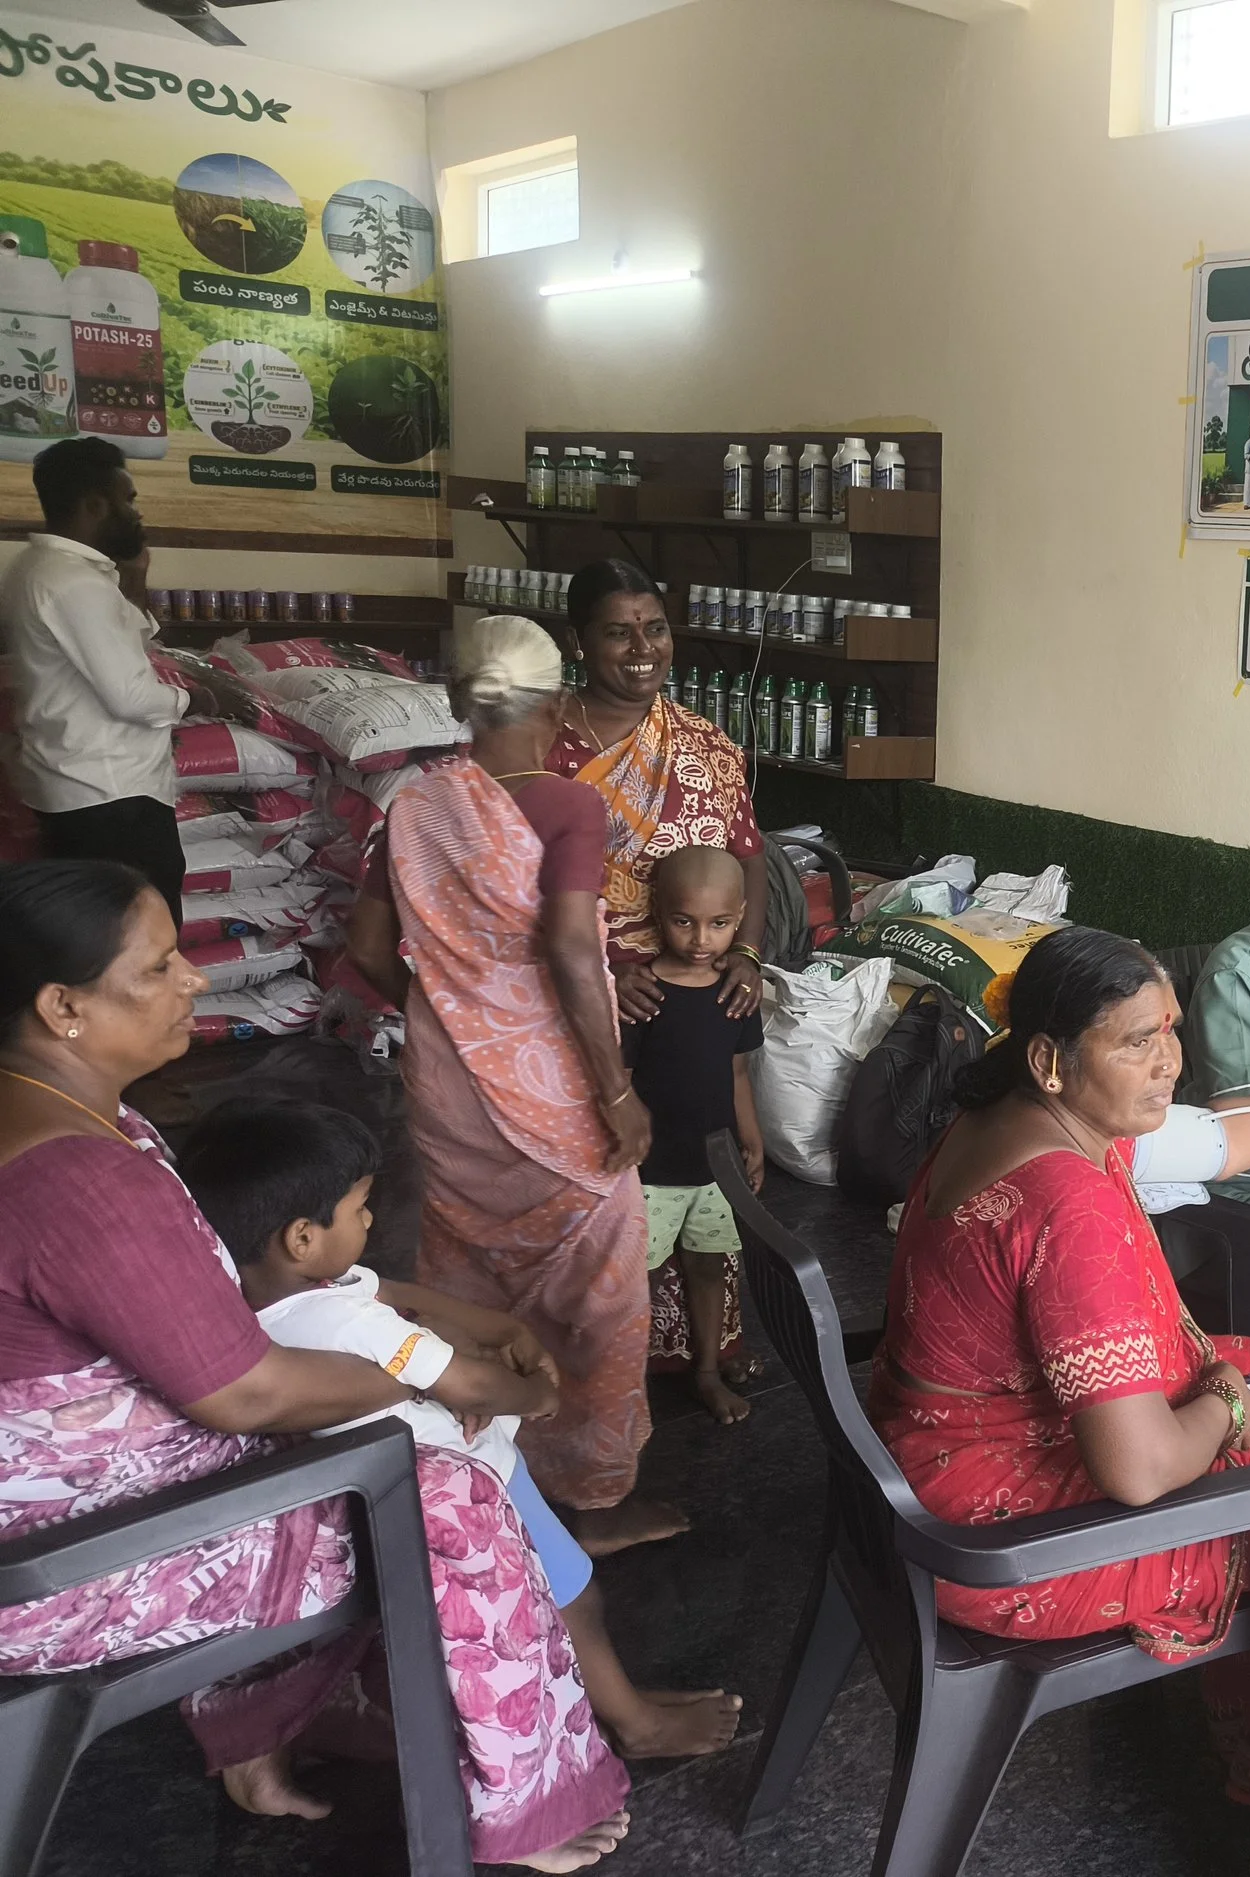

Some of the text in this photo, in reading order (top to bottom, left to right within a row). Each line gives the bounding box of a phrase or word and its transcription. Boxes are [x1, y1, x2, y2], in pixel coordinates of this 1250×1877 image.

[193, 280, 298, 309] పంట నాణ్యత
[74, 326, 153, 348] POTASH-25
[0, 373, 68, 397] eedUp
[880, 924, 966, 968] CultivaTec
